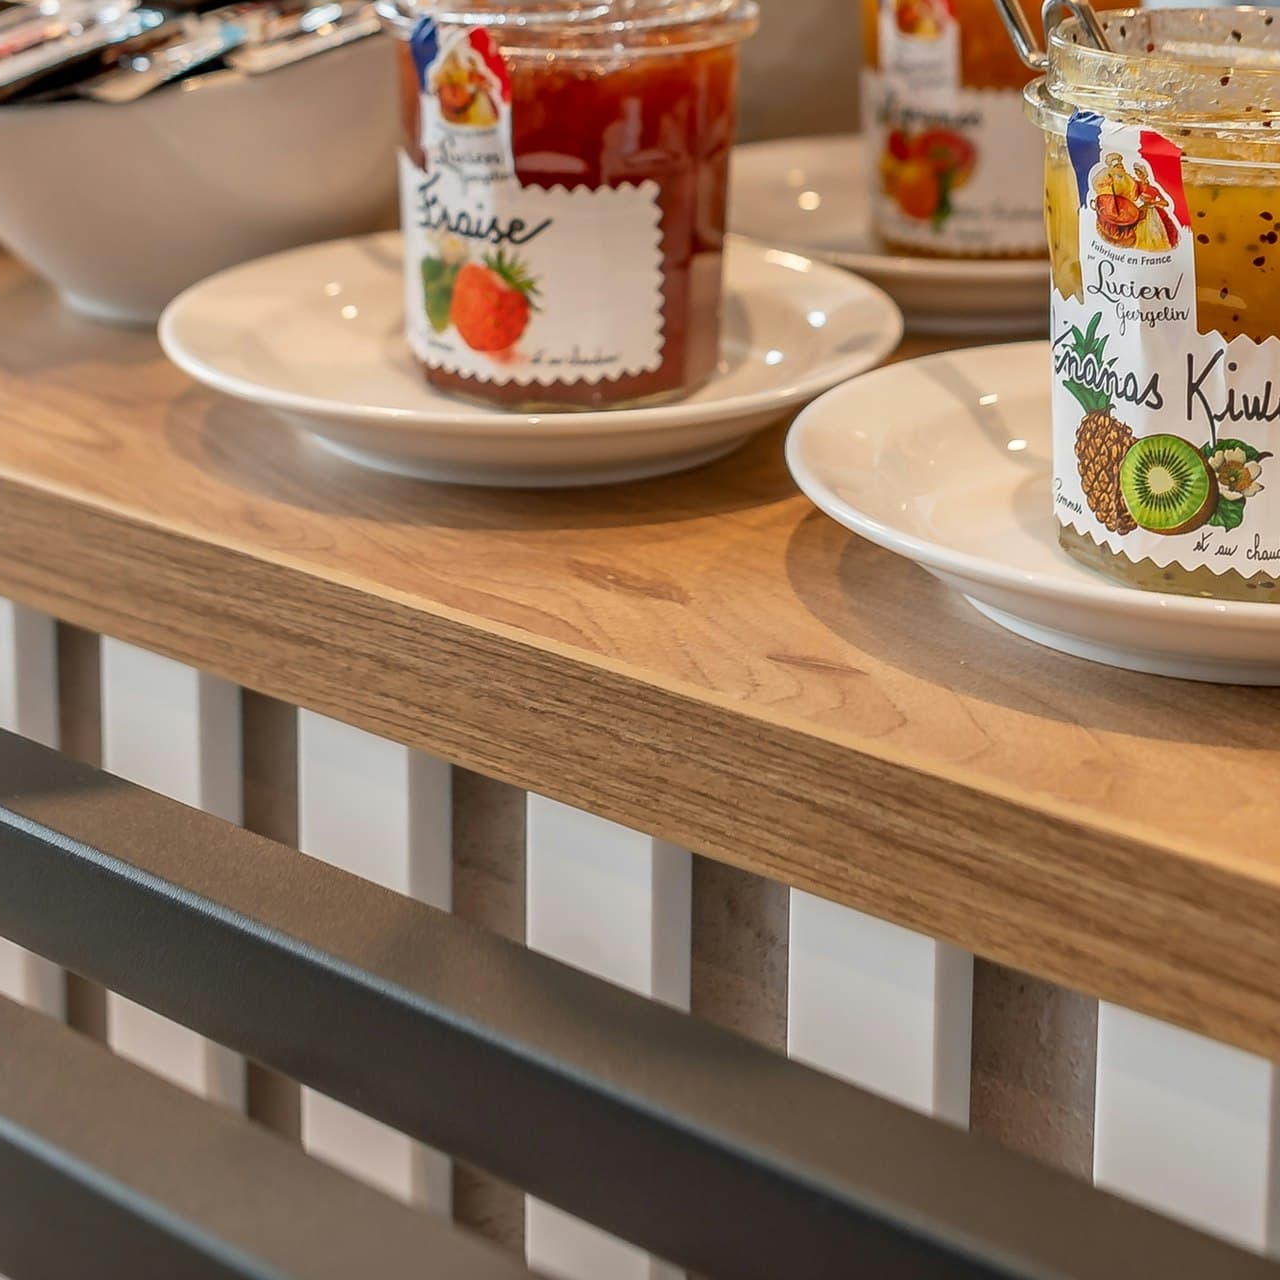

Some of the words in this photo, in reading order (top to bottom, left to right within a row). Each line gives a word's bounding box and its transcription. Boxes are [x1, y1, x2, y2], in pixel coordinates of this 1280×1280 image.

[418, 172, 554, 244] Fraise
[1086, 259, 1184, 303] Lucien
[1127, 256, 1138, 265] en
[1141, 255, 1173, 266] France
[1053, 330, 1164, 410] nanas
[1192, 531, 1214, 552] et
[1214, 544, 1239, 556] au
